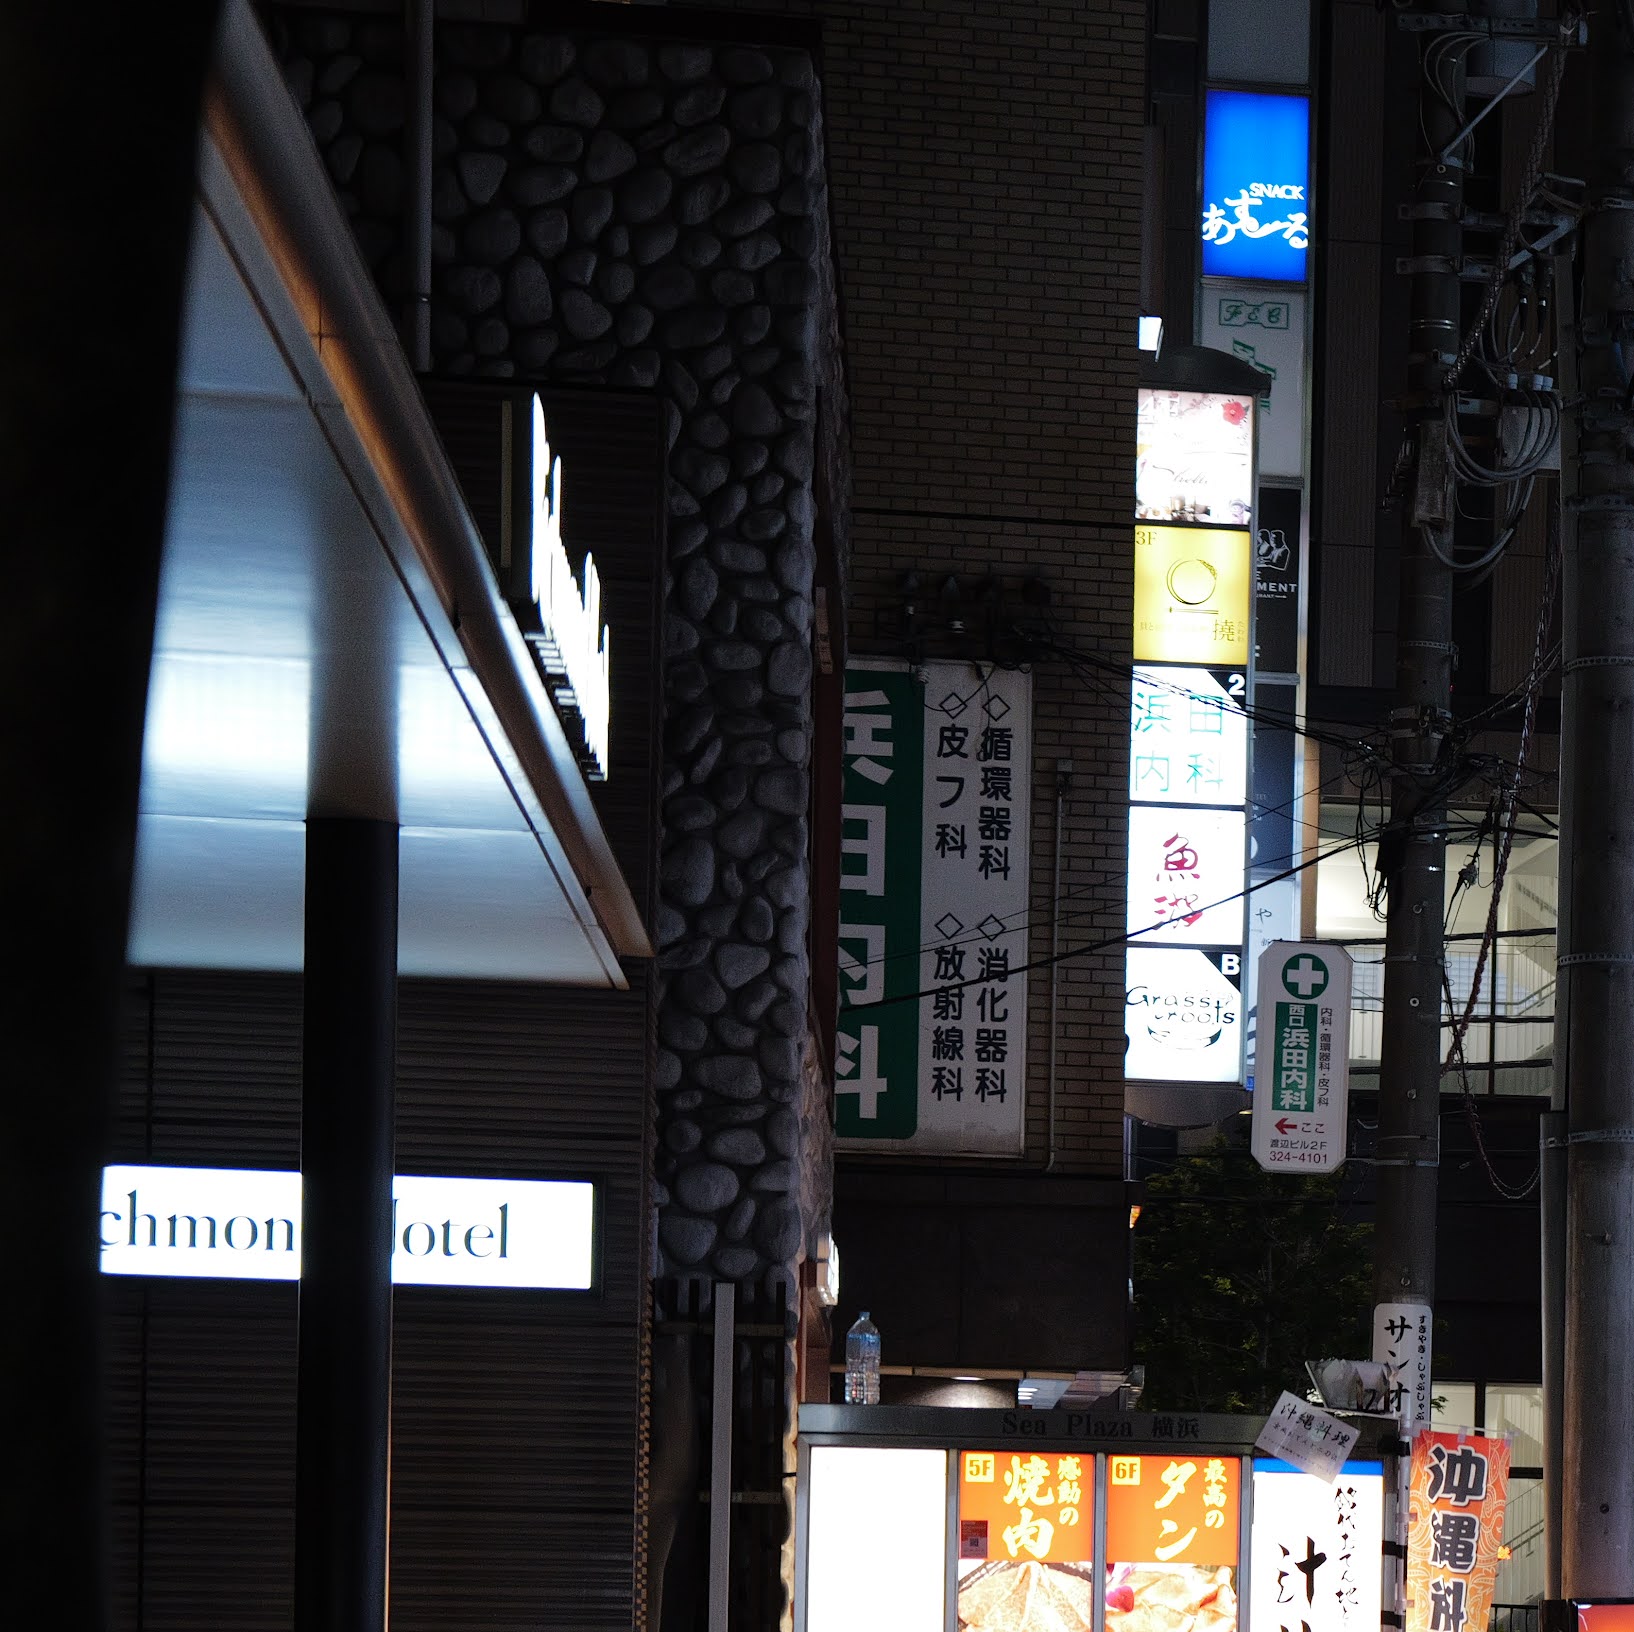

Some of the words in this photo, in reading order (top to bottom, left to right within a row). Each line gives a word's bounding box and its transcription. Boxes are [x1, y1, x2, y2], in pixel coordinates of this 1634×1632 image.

[1249, 182, 1305, 200] SNACK
[1136, 532, 1157, 545] 3F
[1134, 691, 1224, 735] 浜田
[935, 723, 969, 860] 皮フ科
[1135, 751, 1224, 794] 内科
[978, 726, 1013, 881] 循環器科
[931, 945, 966, 1102] 放射線科
[974, 946, 1010, 1104] 消化器科
[1301, 1122, 1325, 1134] ここ
[1269, 1151, 1328, 1164] 324-4101
[100, 1190, 295, 1253] chmon
[392, 1199, 511, 1259] otel
[1001, 1411, 1047, 1436] Sea
[1065, 1413, 1133, 1437] Plaza
[1280, 1403, 1351, 1448] 沖縄料理
[968, 1459, 991, 1477] 5F
[1115, 1462, 1138, 1478] 6F
[1002, 1455, 1055, 1559] 焼肉
[1057, 1456, 1083, 1526] 感動の
[1154, 1461, 1198, 1562] タン
[1203, 1459, 1227, 1529] 最高の
